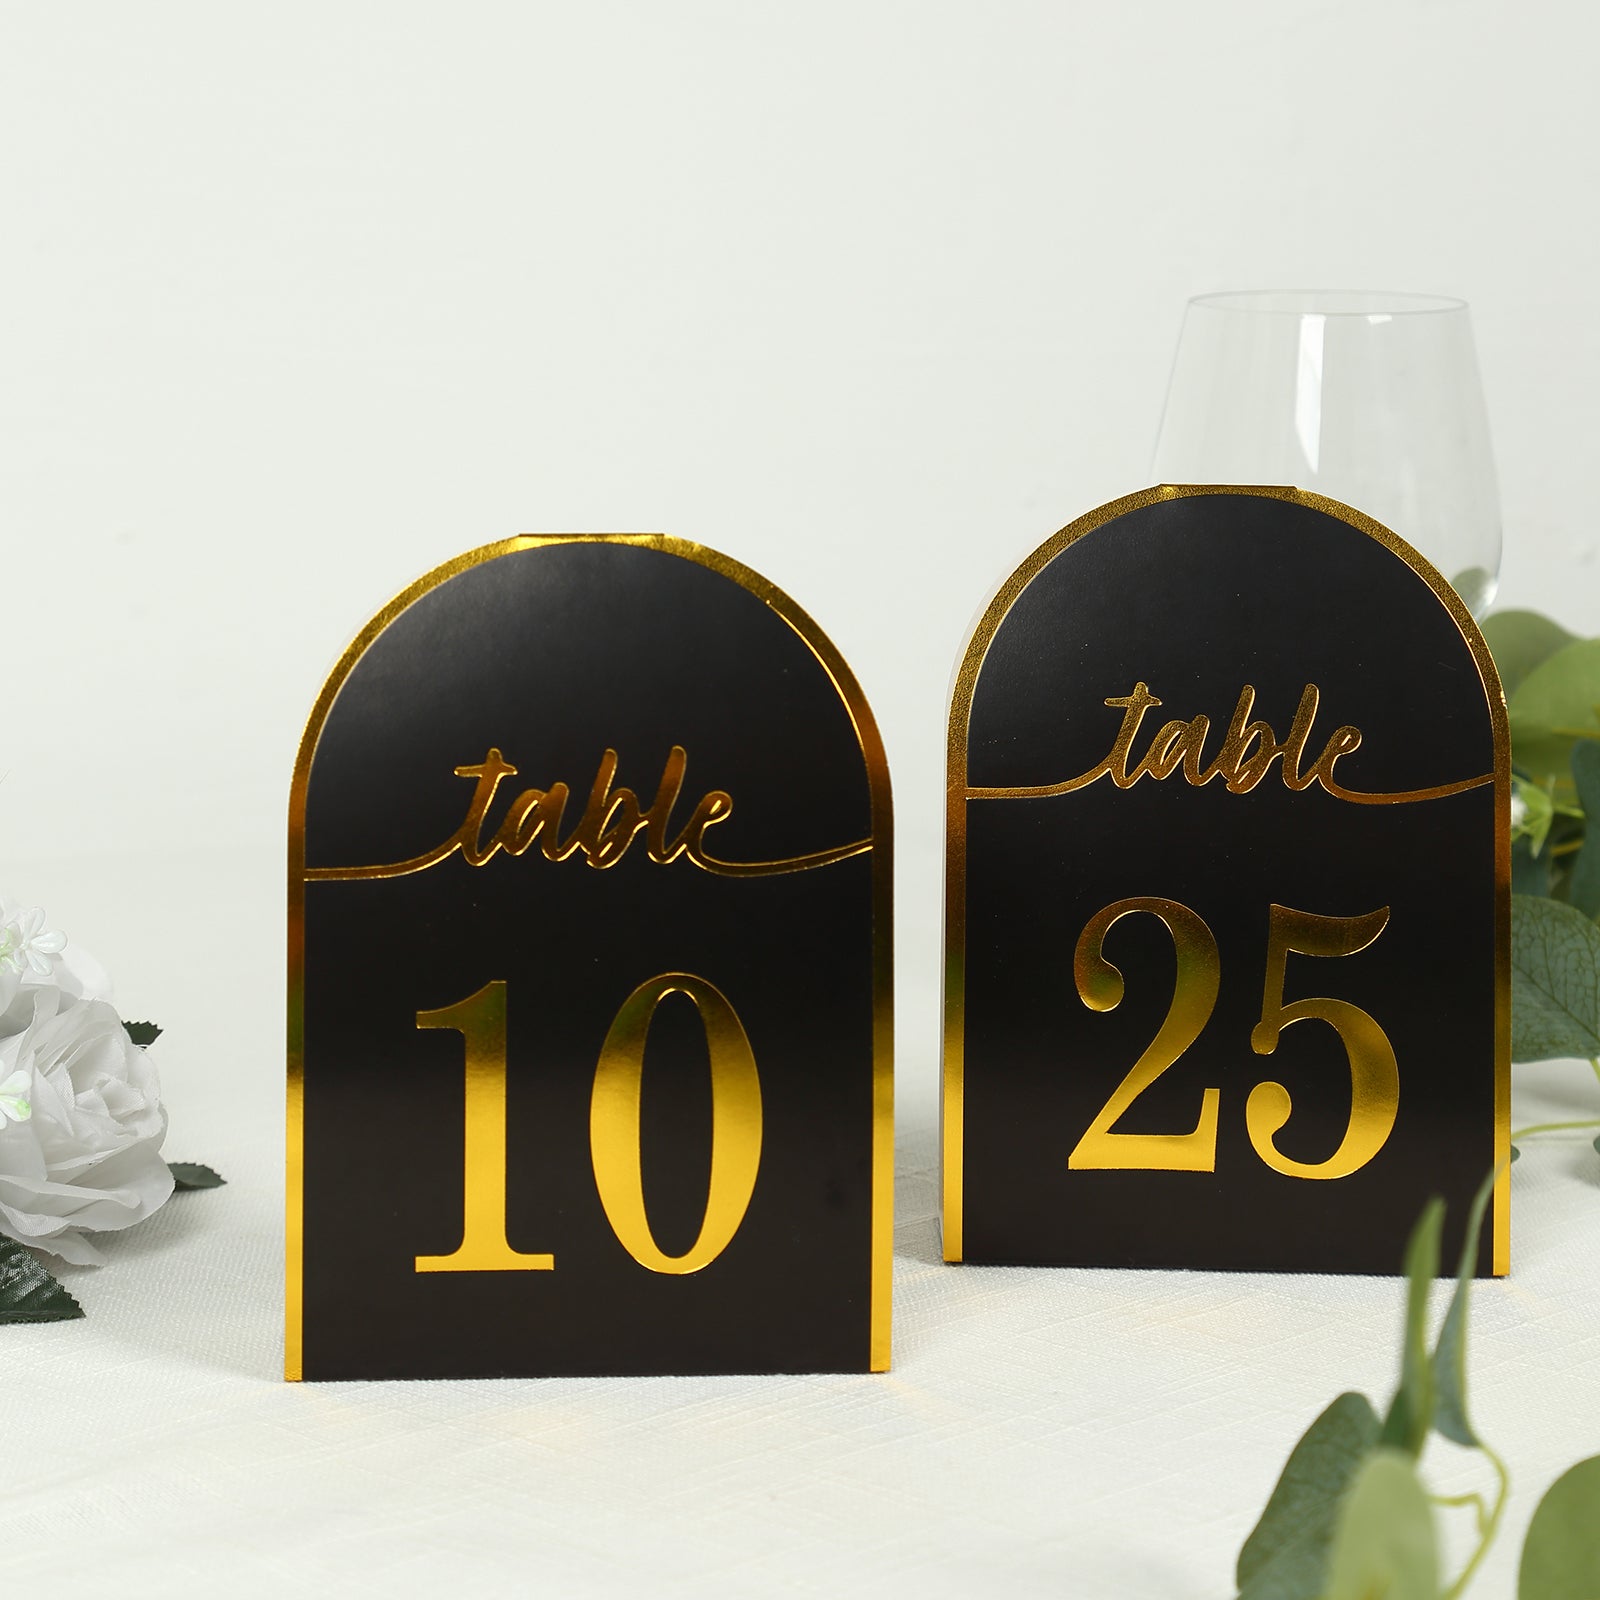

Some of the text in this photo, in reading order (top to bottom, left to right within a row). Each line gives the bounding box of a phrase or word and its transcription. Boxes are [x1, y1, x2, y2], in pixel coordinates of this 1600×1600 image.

[453, 745, 735, 874] table
[1103, 681, 1363, 801] table
[413, 971, 764, 1276] 10
[1067, 896, 1401, 1181] 25
